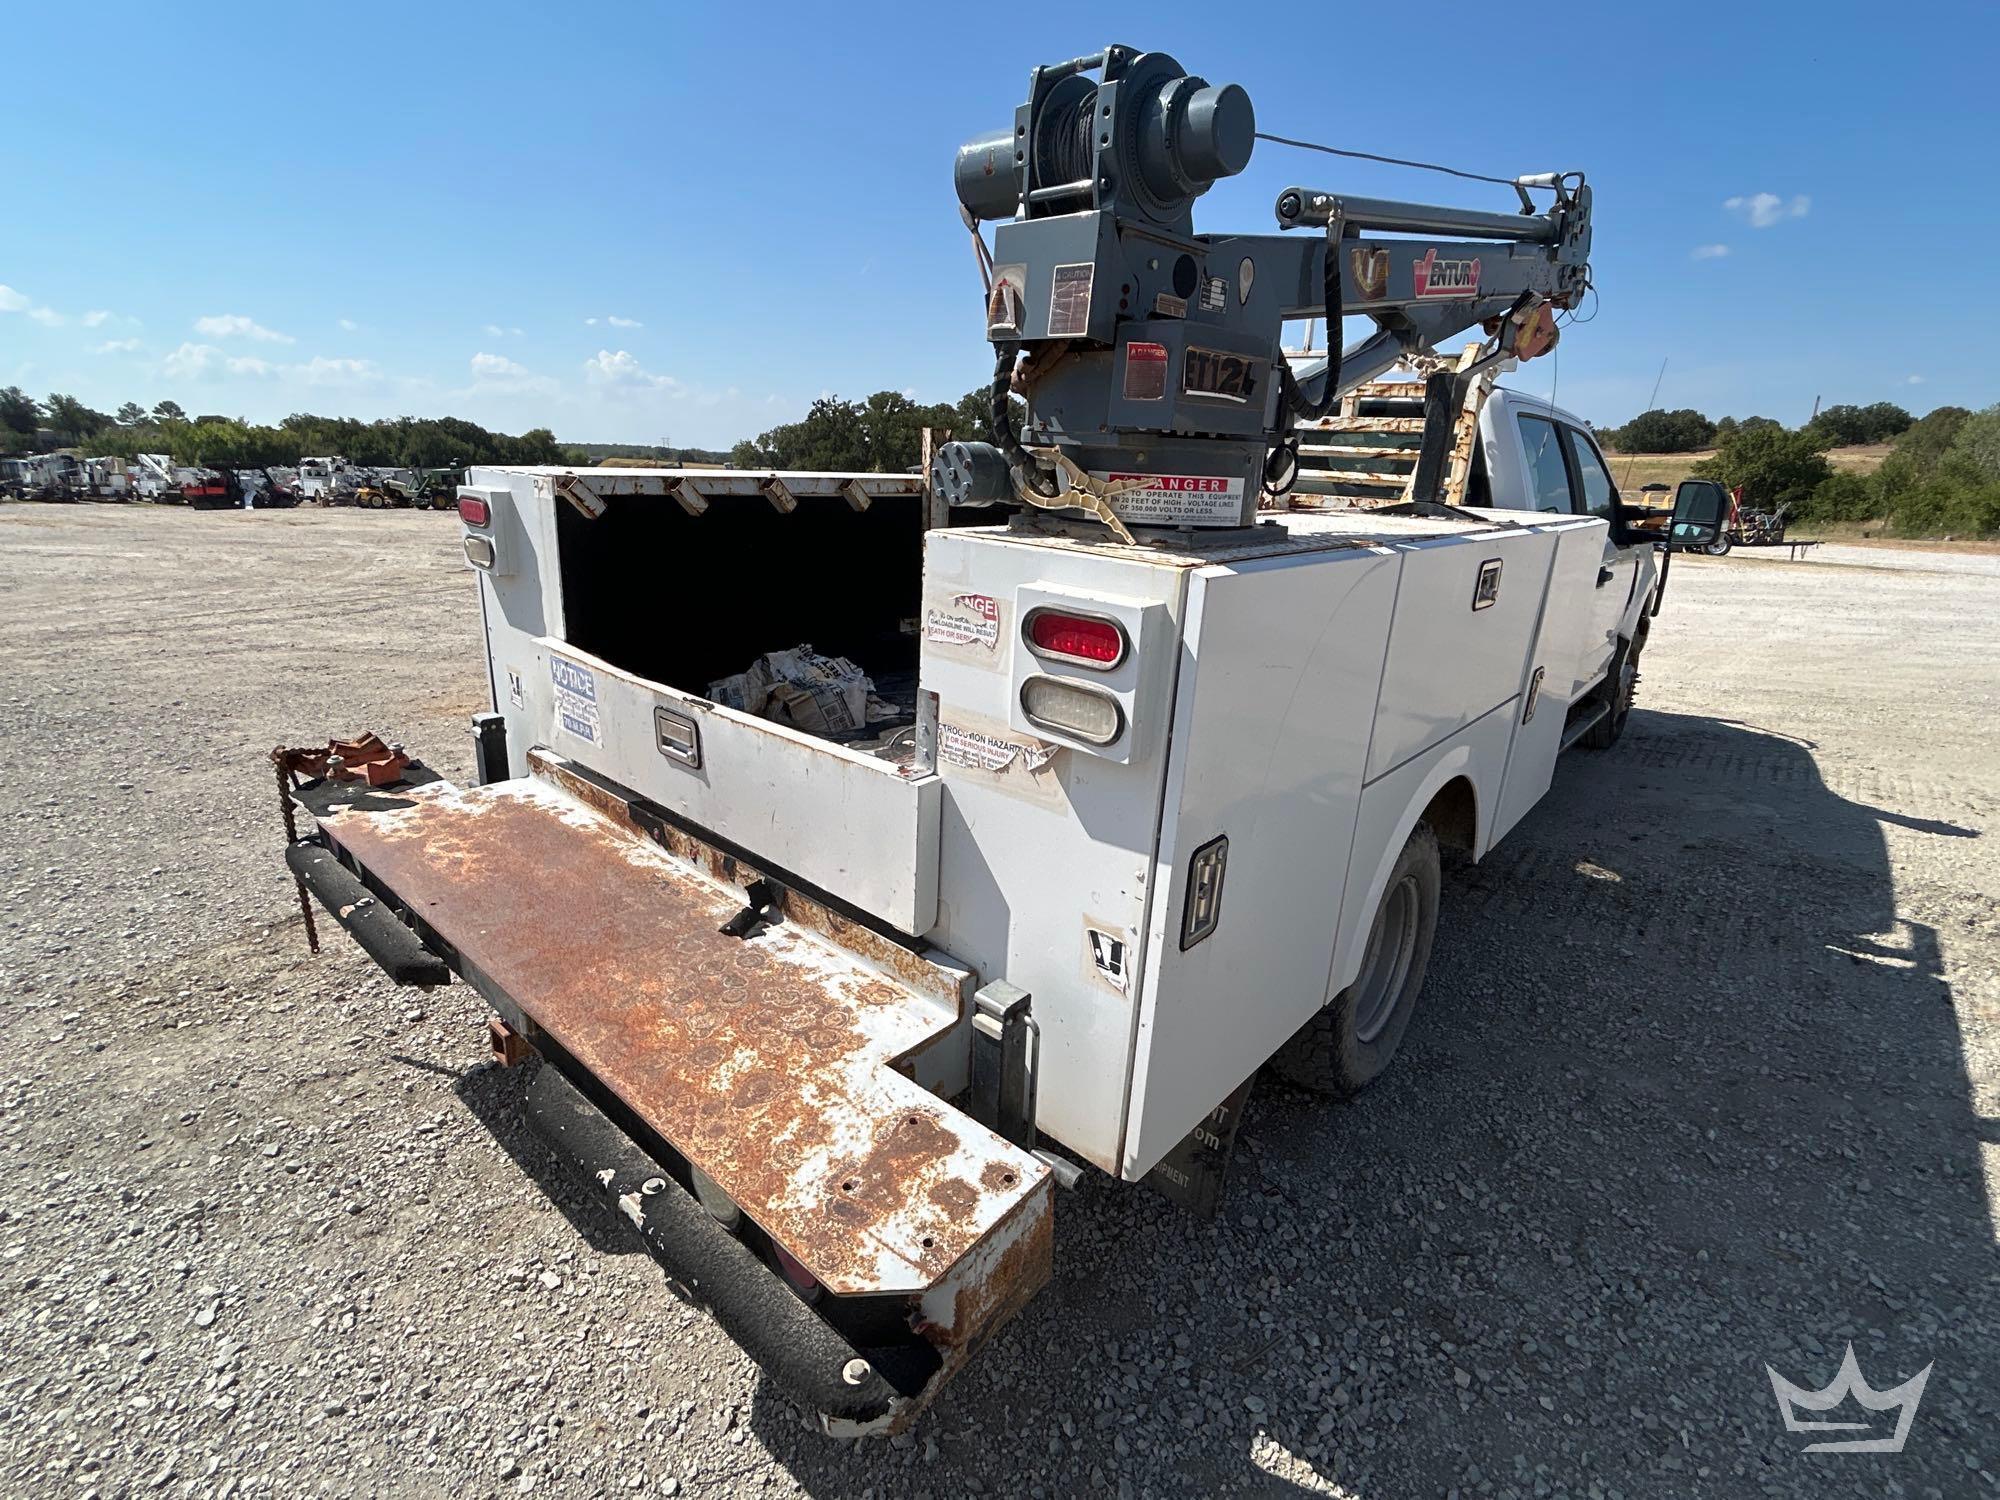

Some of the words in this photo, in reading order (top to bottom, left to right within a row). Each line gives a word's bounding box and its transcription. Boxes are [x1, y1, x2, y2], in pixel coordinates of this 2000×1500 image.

[1146, 491, 1183, 499] OPERATE
[553, 660, 594, 697] NOTICE
[951, 736, 960, 744] OR
[960, 739, 986, 752] SERIOUS
[987, 747, 1009, 760] INJURY
[1194, 1127, 1220, 1150] om
